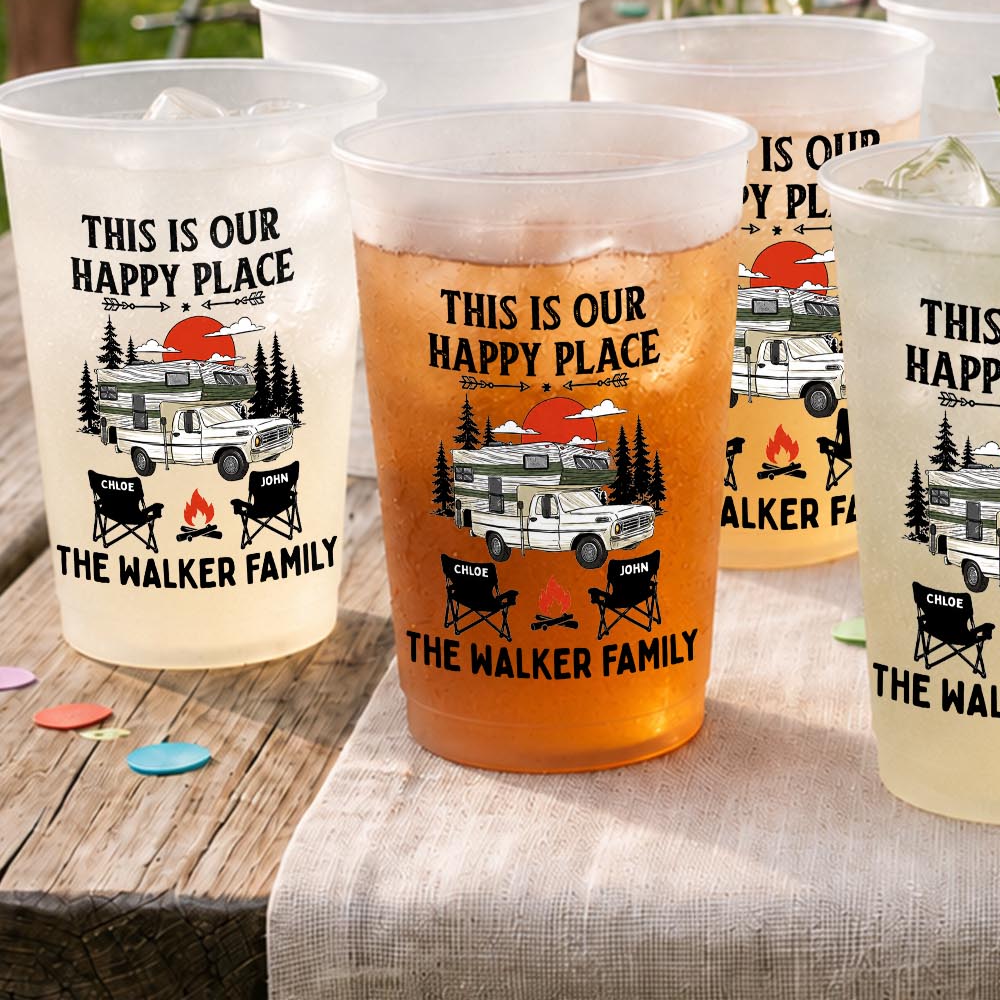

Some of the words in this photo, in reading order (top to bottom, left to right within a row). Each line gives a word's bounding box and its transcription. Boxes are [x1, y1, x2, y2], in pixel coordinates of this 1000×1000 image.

[762, 136, 792, 172] IS
[82, 215, 156, 252] THIS
[168, 218, 198, 252] IS
[210, 208, 280, 245] OUR
[71, 257, 180, 297] HAPPY
[193, 248, 294, 295] PLACE
[441, 289, 517, 329] THIS
[531, 296, 560, 330] IS
[574, 286, 646, 327] OUR
[429, 333, 540, 376] HAPPY
[555, 329, 660, 376] PLACE
[101, 477, 134, 491] CHLOE
[259, 470, 288, 486] JOHN
[721, 496, 818, 530] ALKER
[57, 542, 112, 583] THE
[119, 555, 235, 588] WALKER
[246, 536, 337, 584] FAMILY
[454, 565, 488, 577] CHLOE
[620, 562, 648, 575] JOHN
[926, 591, 964, 608] CHLOE
[407, 628, 463, 671] THE
[471, 643, 591, 680] WALKER
[603, 629, 697, 676] FAMILY
[873, 662, 931, 708] THE
